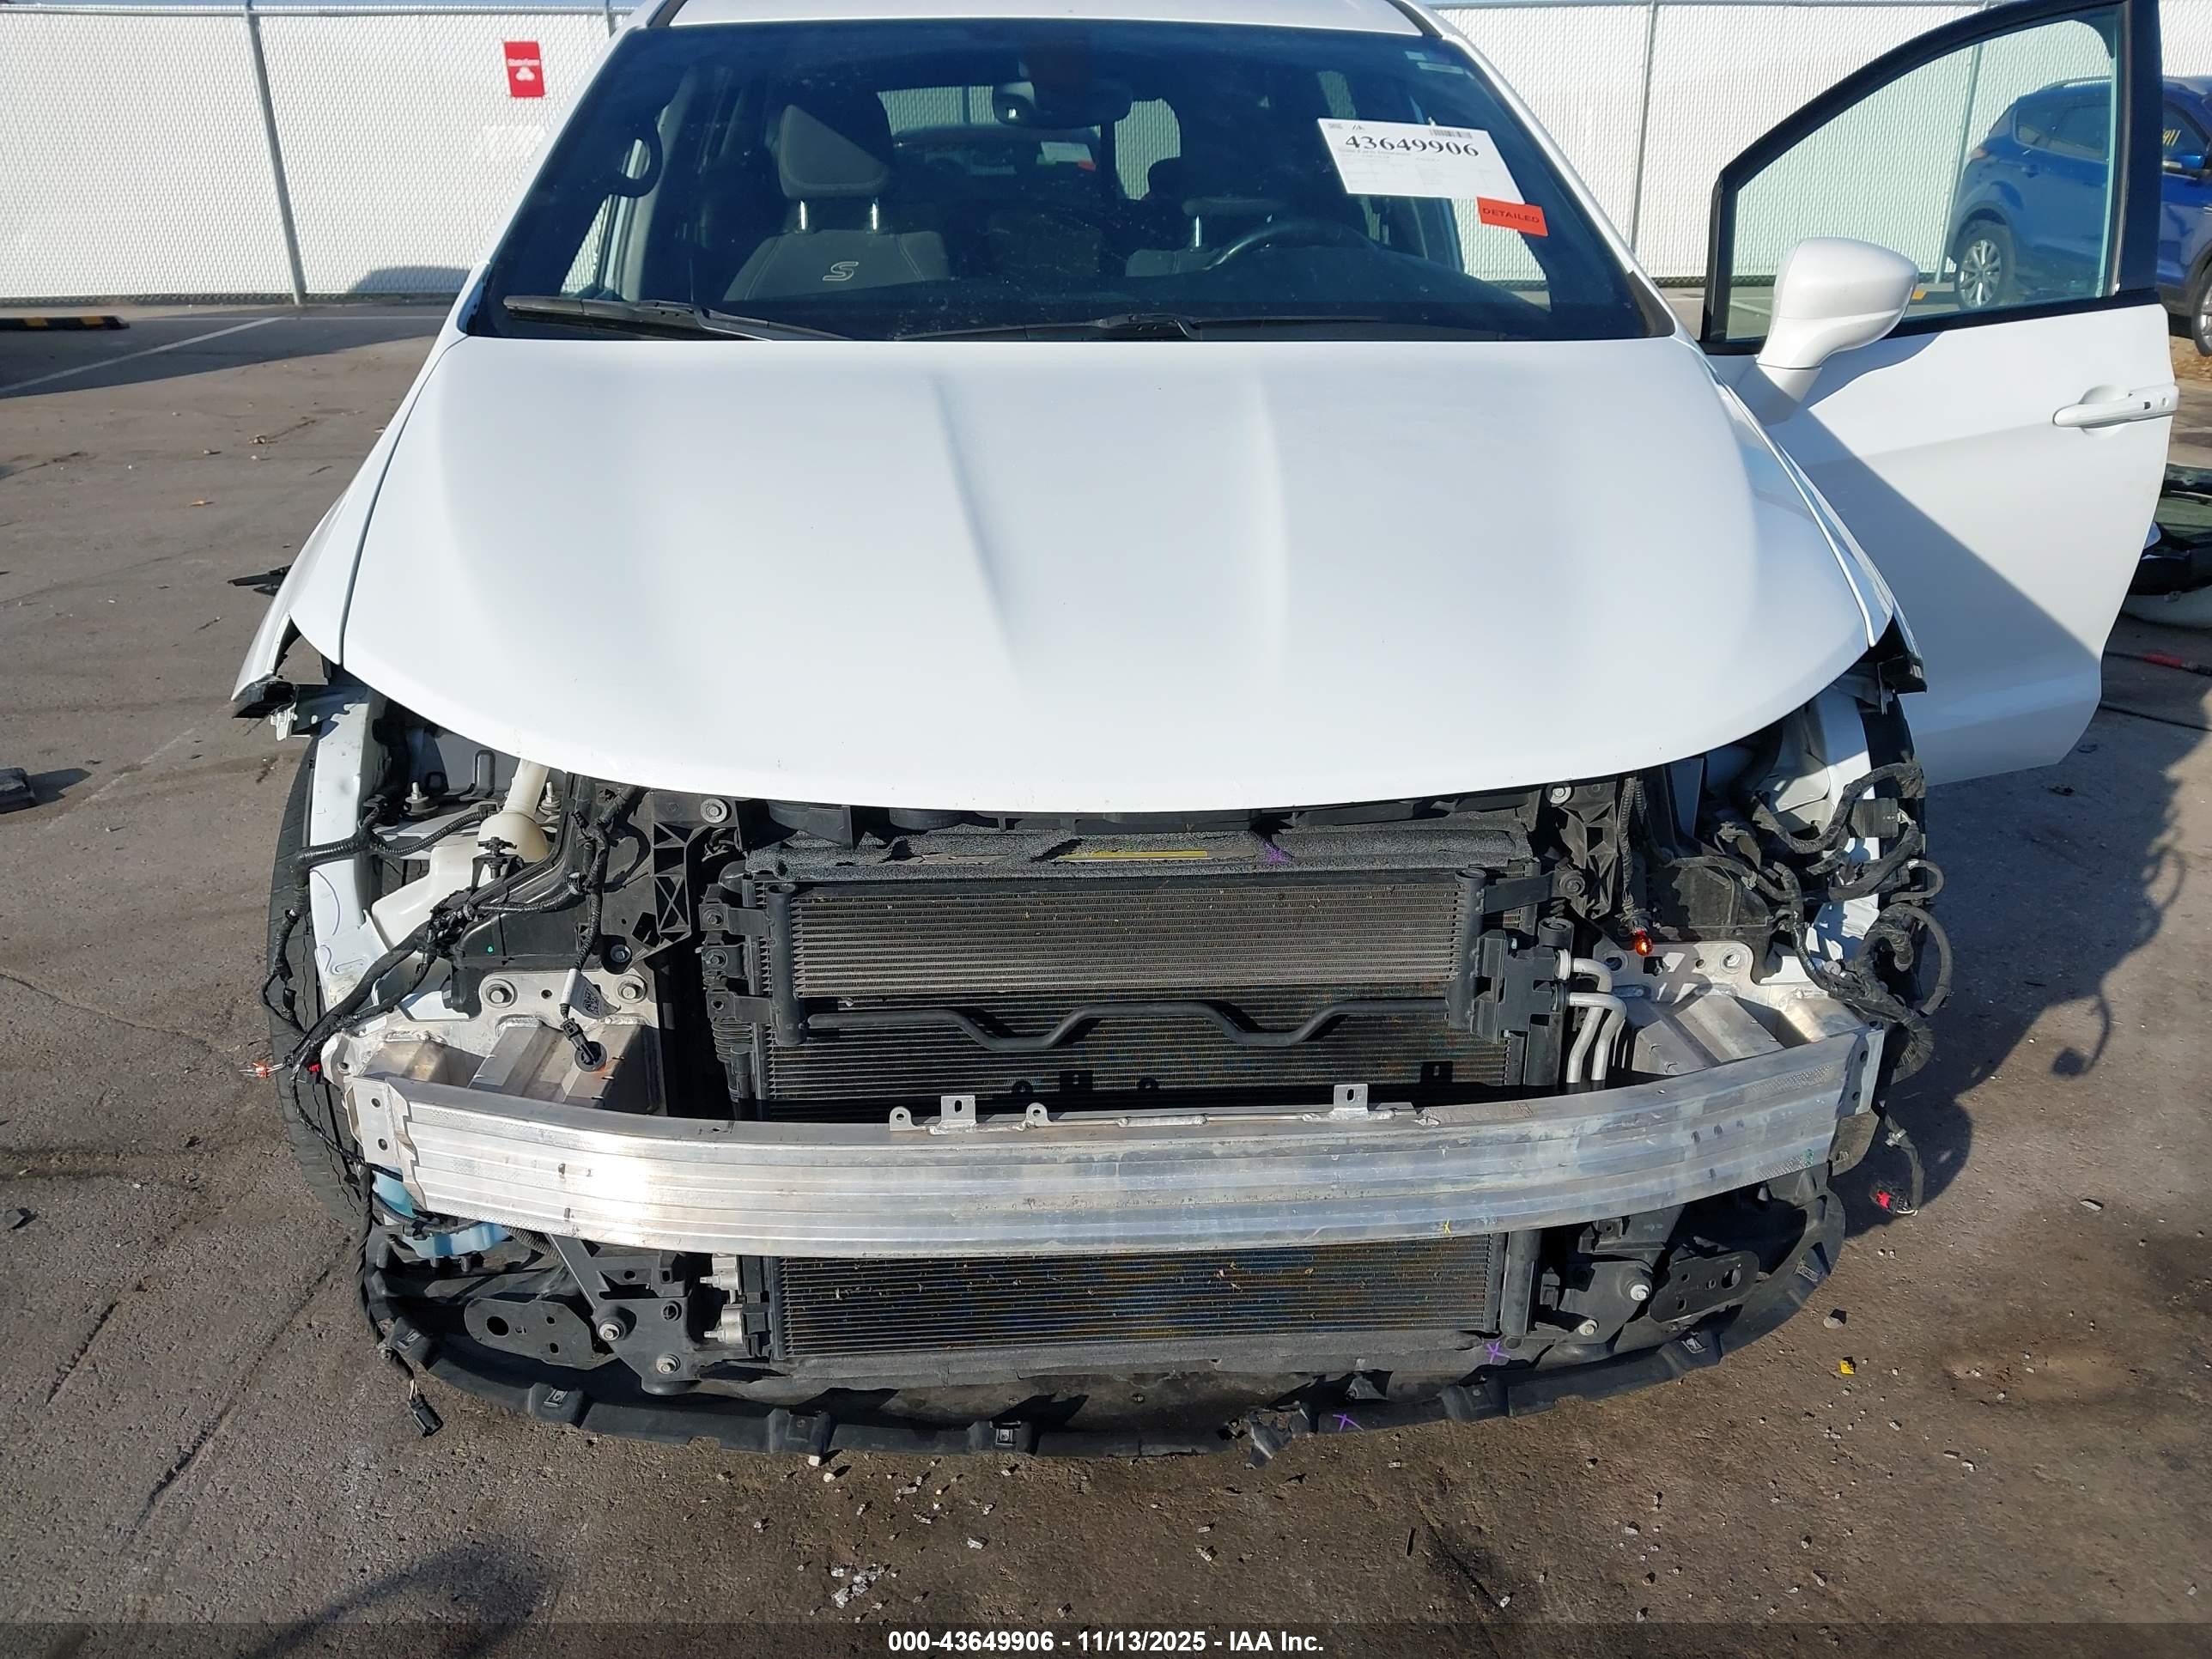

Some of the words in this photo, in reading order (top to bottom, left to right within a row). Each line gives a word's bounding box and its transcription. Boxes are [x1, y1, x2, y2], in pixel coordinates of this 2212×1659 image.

[1346, 135, 1479, 156] 43649906
[1482, 207, 1540, 223] DETAILED
[822, 261, 860, 281] S
